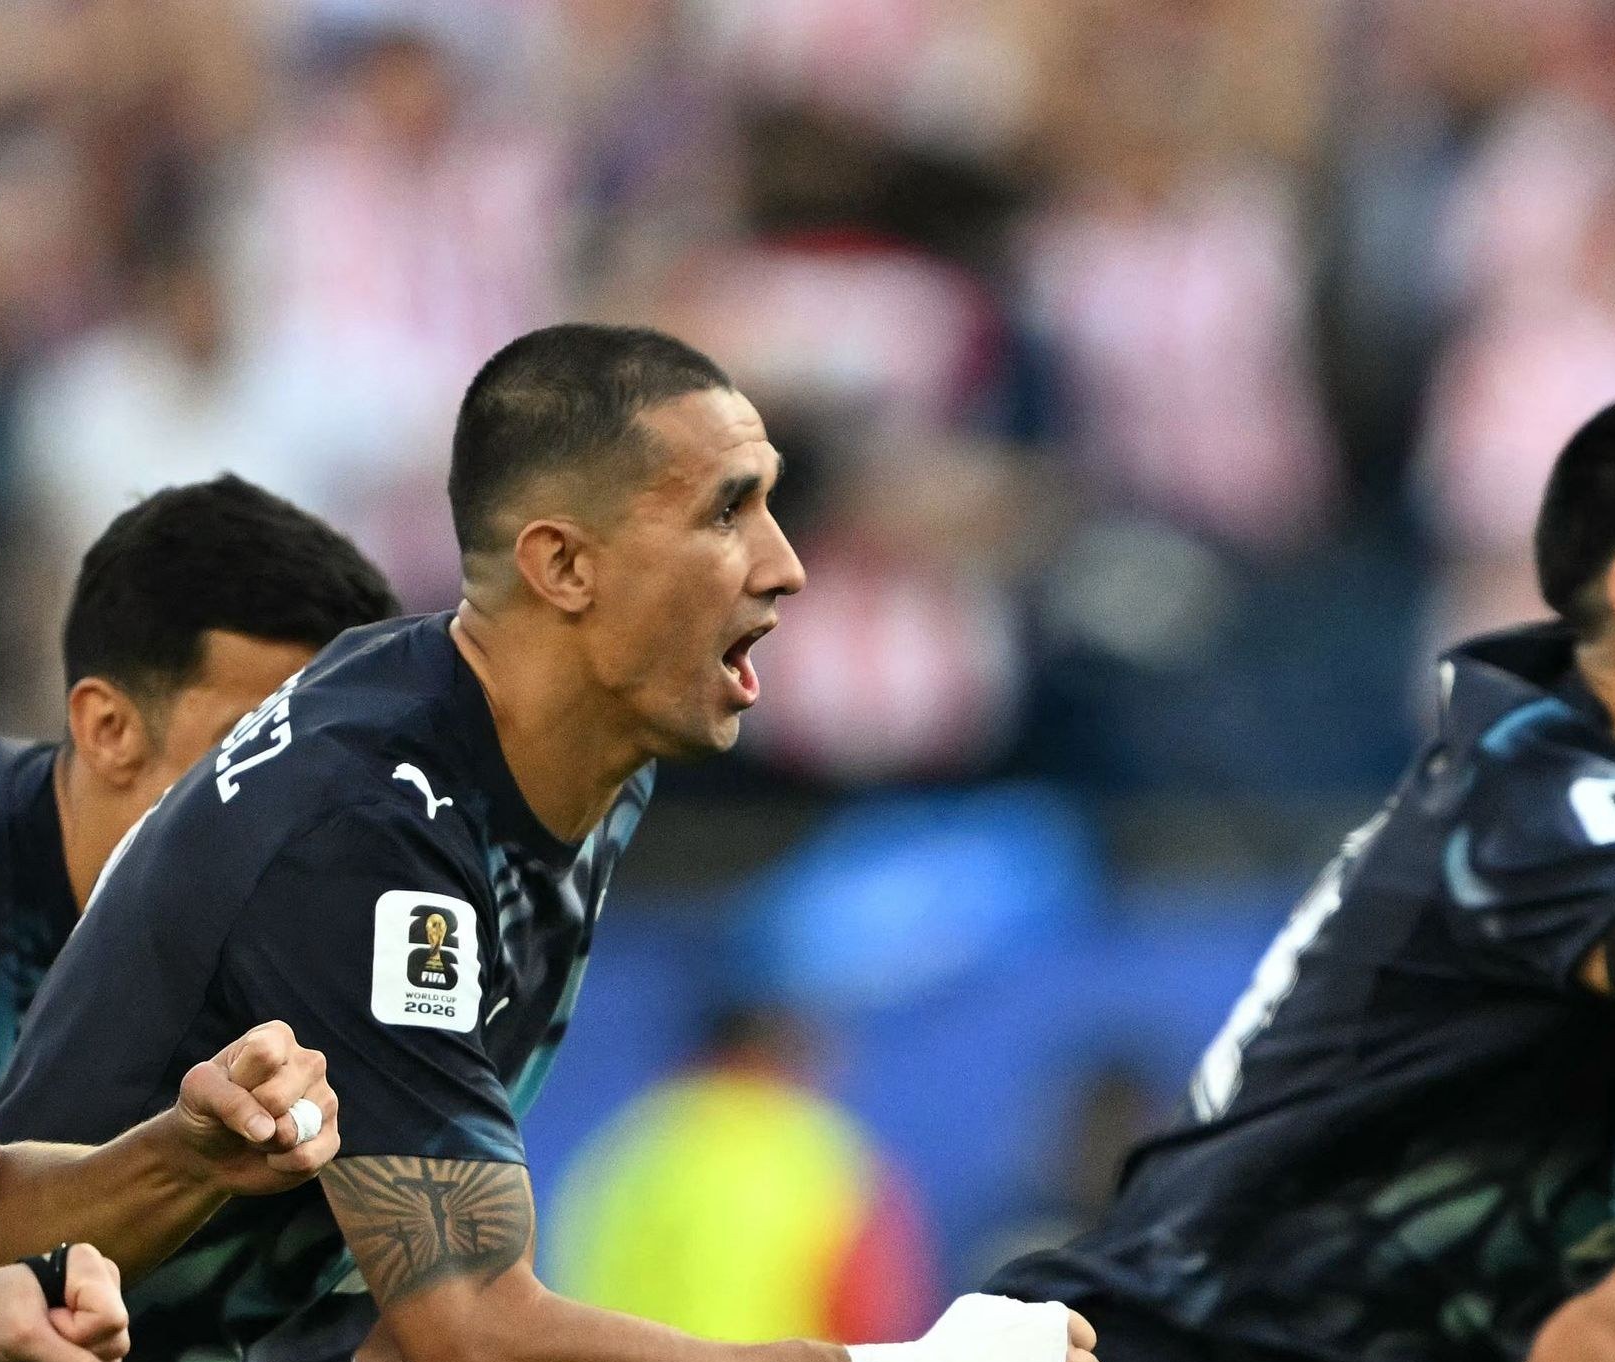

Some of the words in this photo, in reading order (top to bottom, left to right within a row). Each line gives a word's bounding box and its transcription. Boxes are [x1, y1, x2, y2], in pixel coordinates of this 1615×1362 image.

[421, 971, 446, 984] FIFA
[405, 992, 439, 1001] WORLD
[441, 995, 457, 1003] CUP
[404, 1001, 456, 1018] 2026
